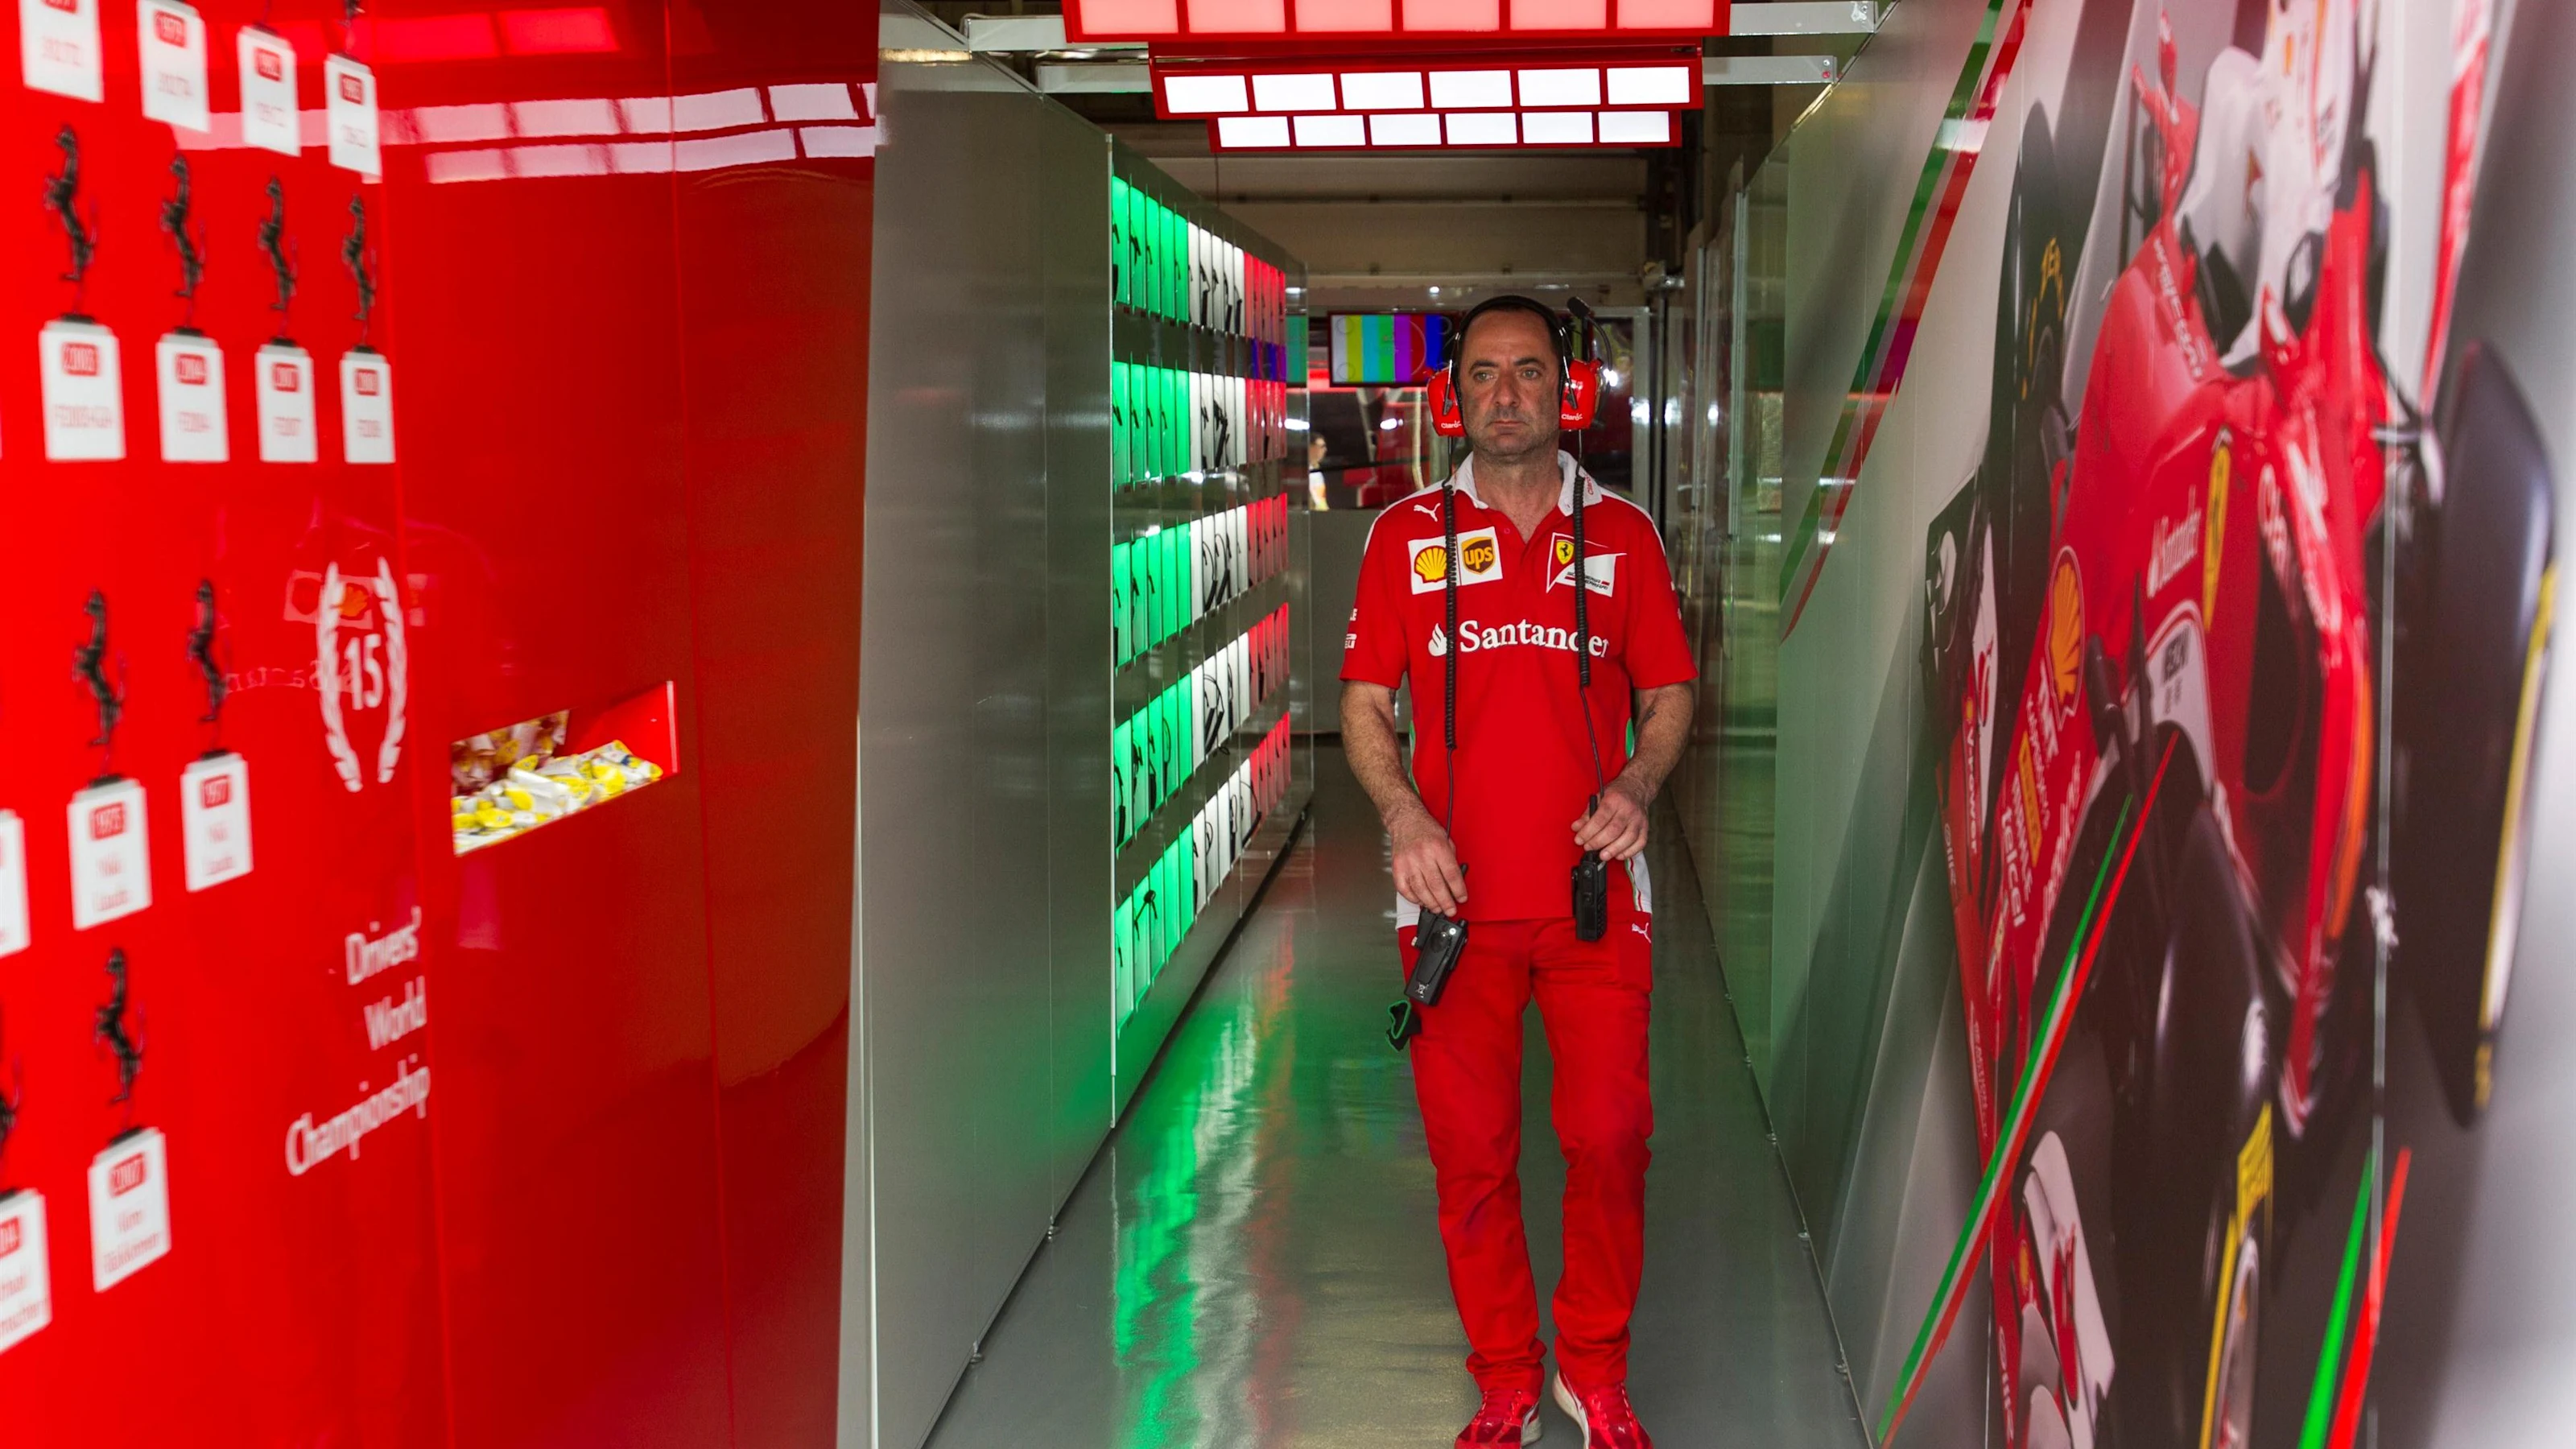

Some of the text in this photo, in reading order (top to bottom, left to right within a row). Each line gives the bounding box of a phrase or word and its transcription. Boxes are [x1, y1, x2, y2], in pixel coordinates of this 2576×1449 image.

[1464, 547, 1493, 569] ups
[345, 634, 384, 710] 15
[2002, 806, 2026, 927] telcel
[364, 975, 427, 1051] World
[285, 1053, 431, 1176] Championship
